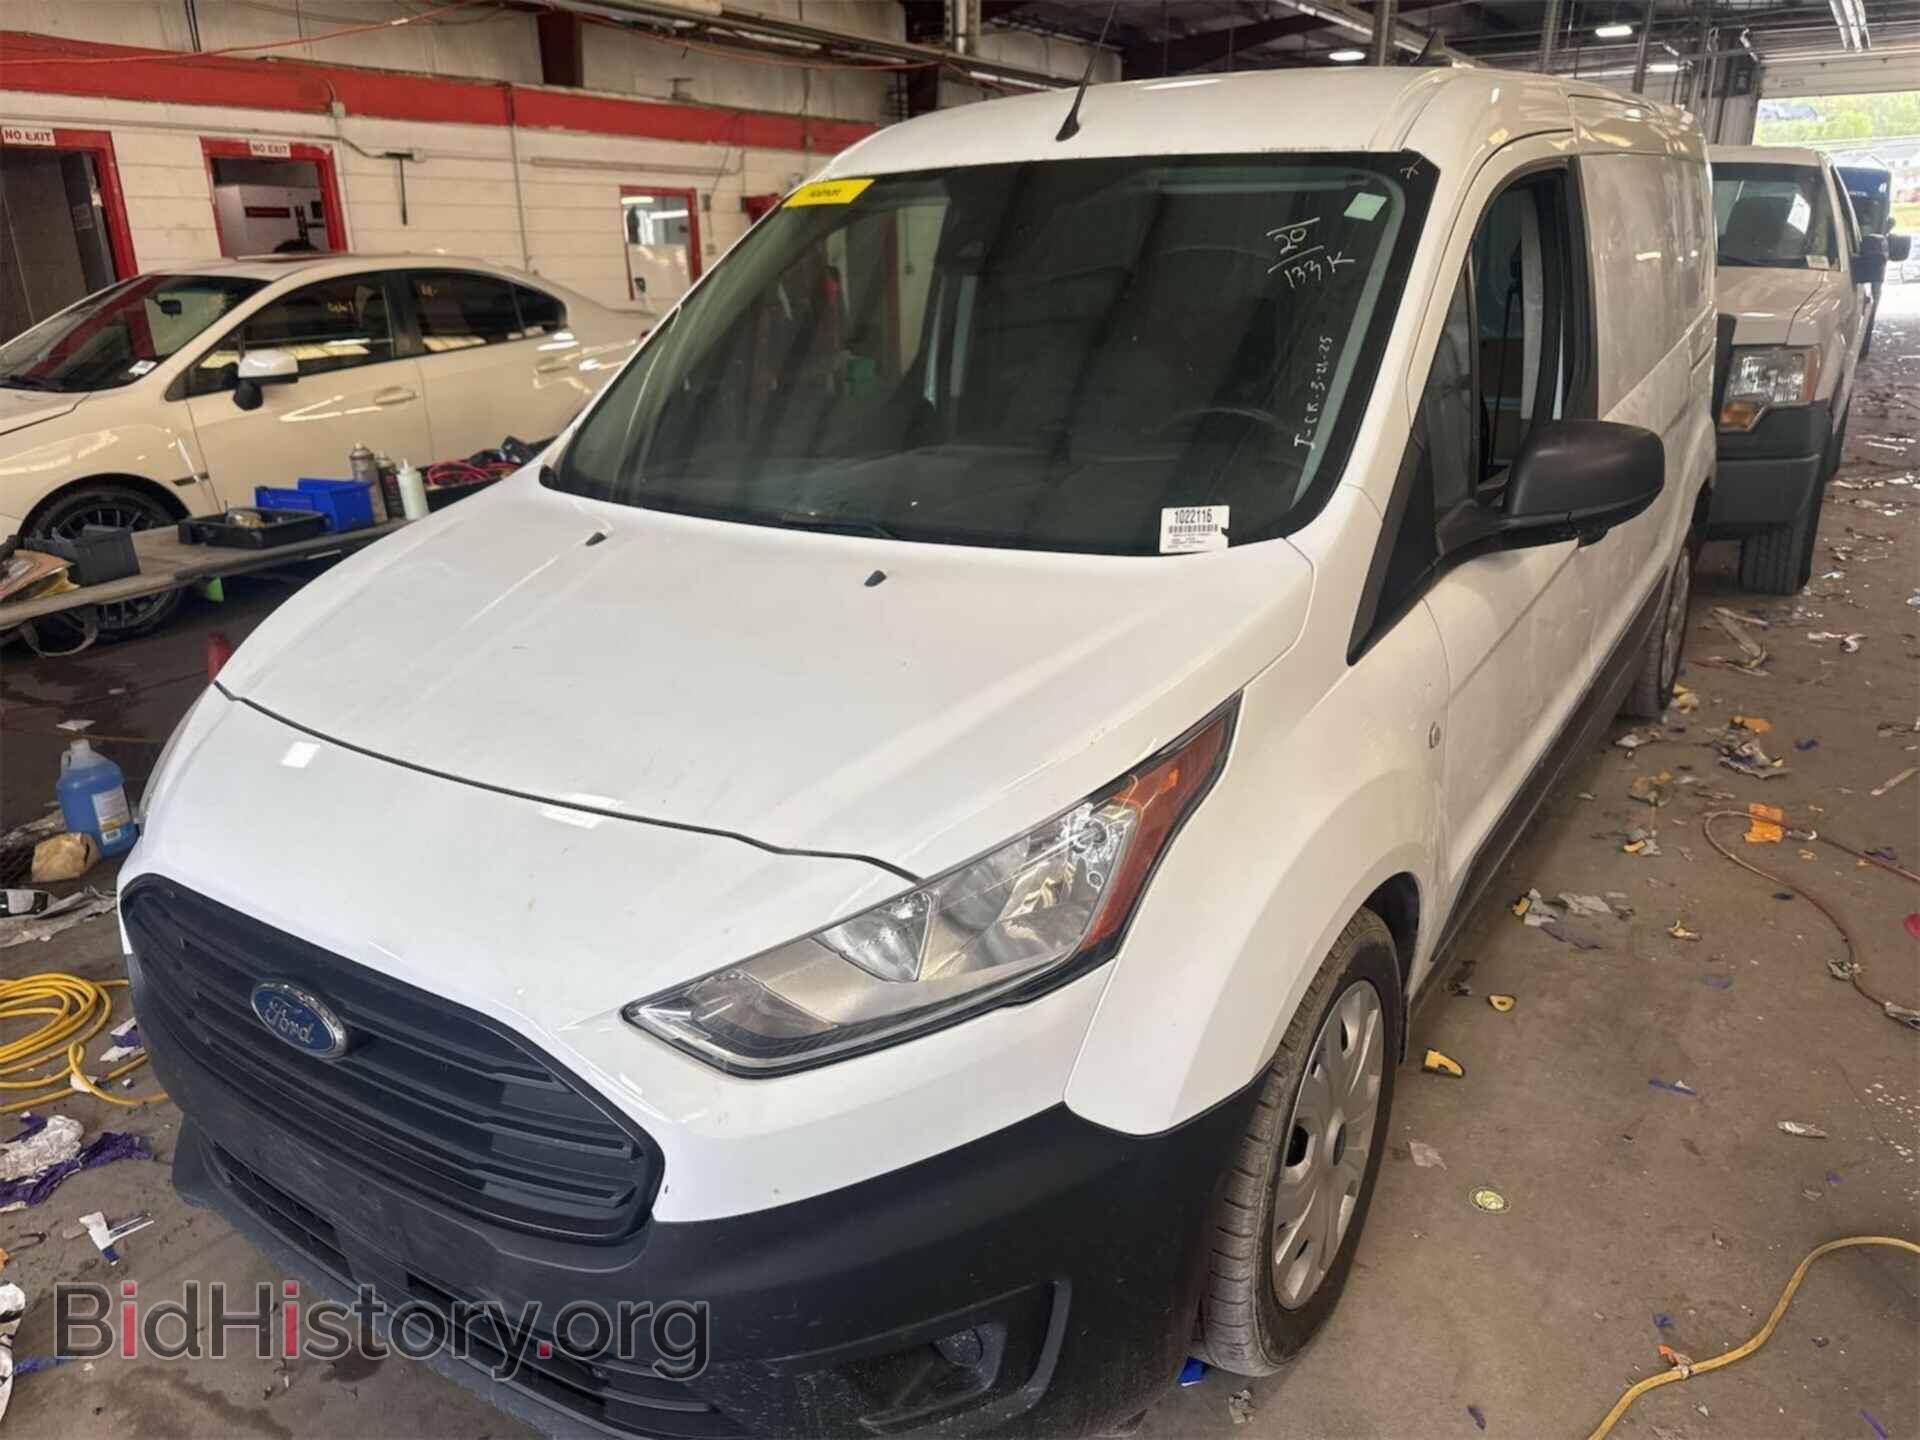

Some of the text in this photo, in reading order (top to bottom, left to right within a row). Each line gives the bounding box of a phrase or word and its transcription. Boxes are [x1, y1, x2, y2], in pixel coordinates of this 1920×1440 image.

[4, 129, 52, 142] NO EXIT
[252, 143, 288, 155] NO EXIT
[263, 994, 316, 1045] Ford
